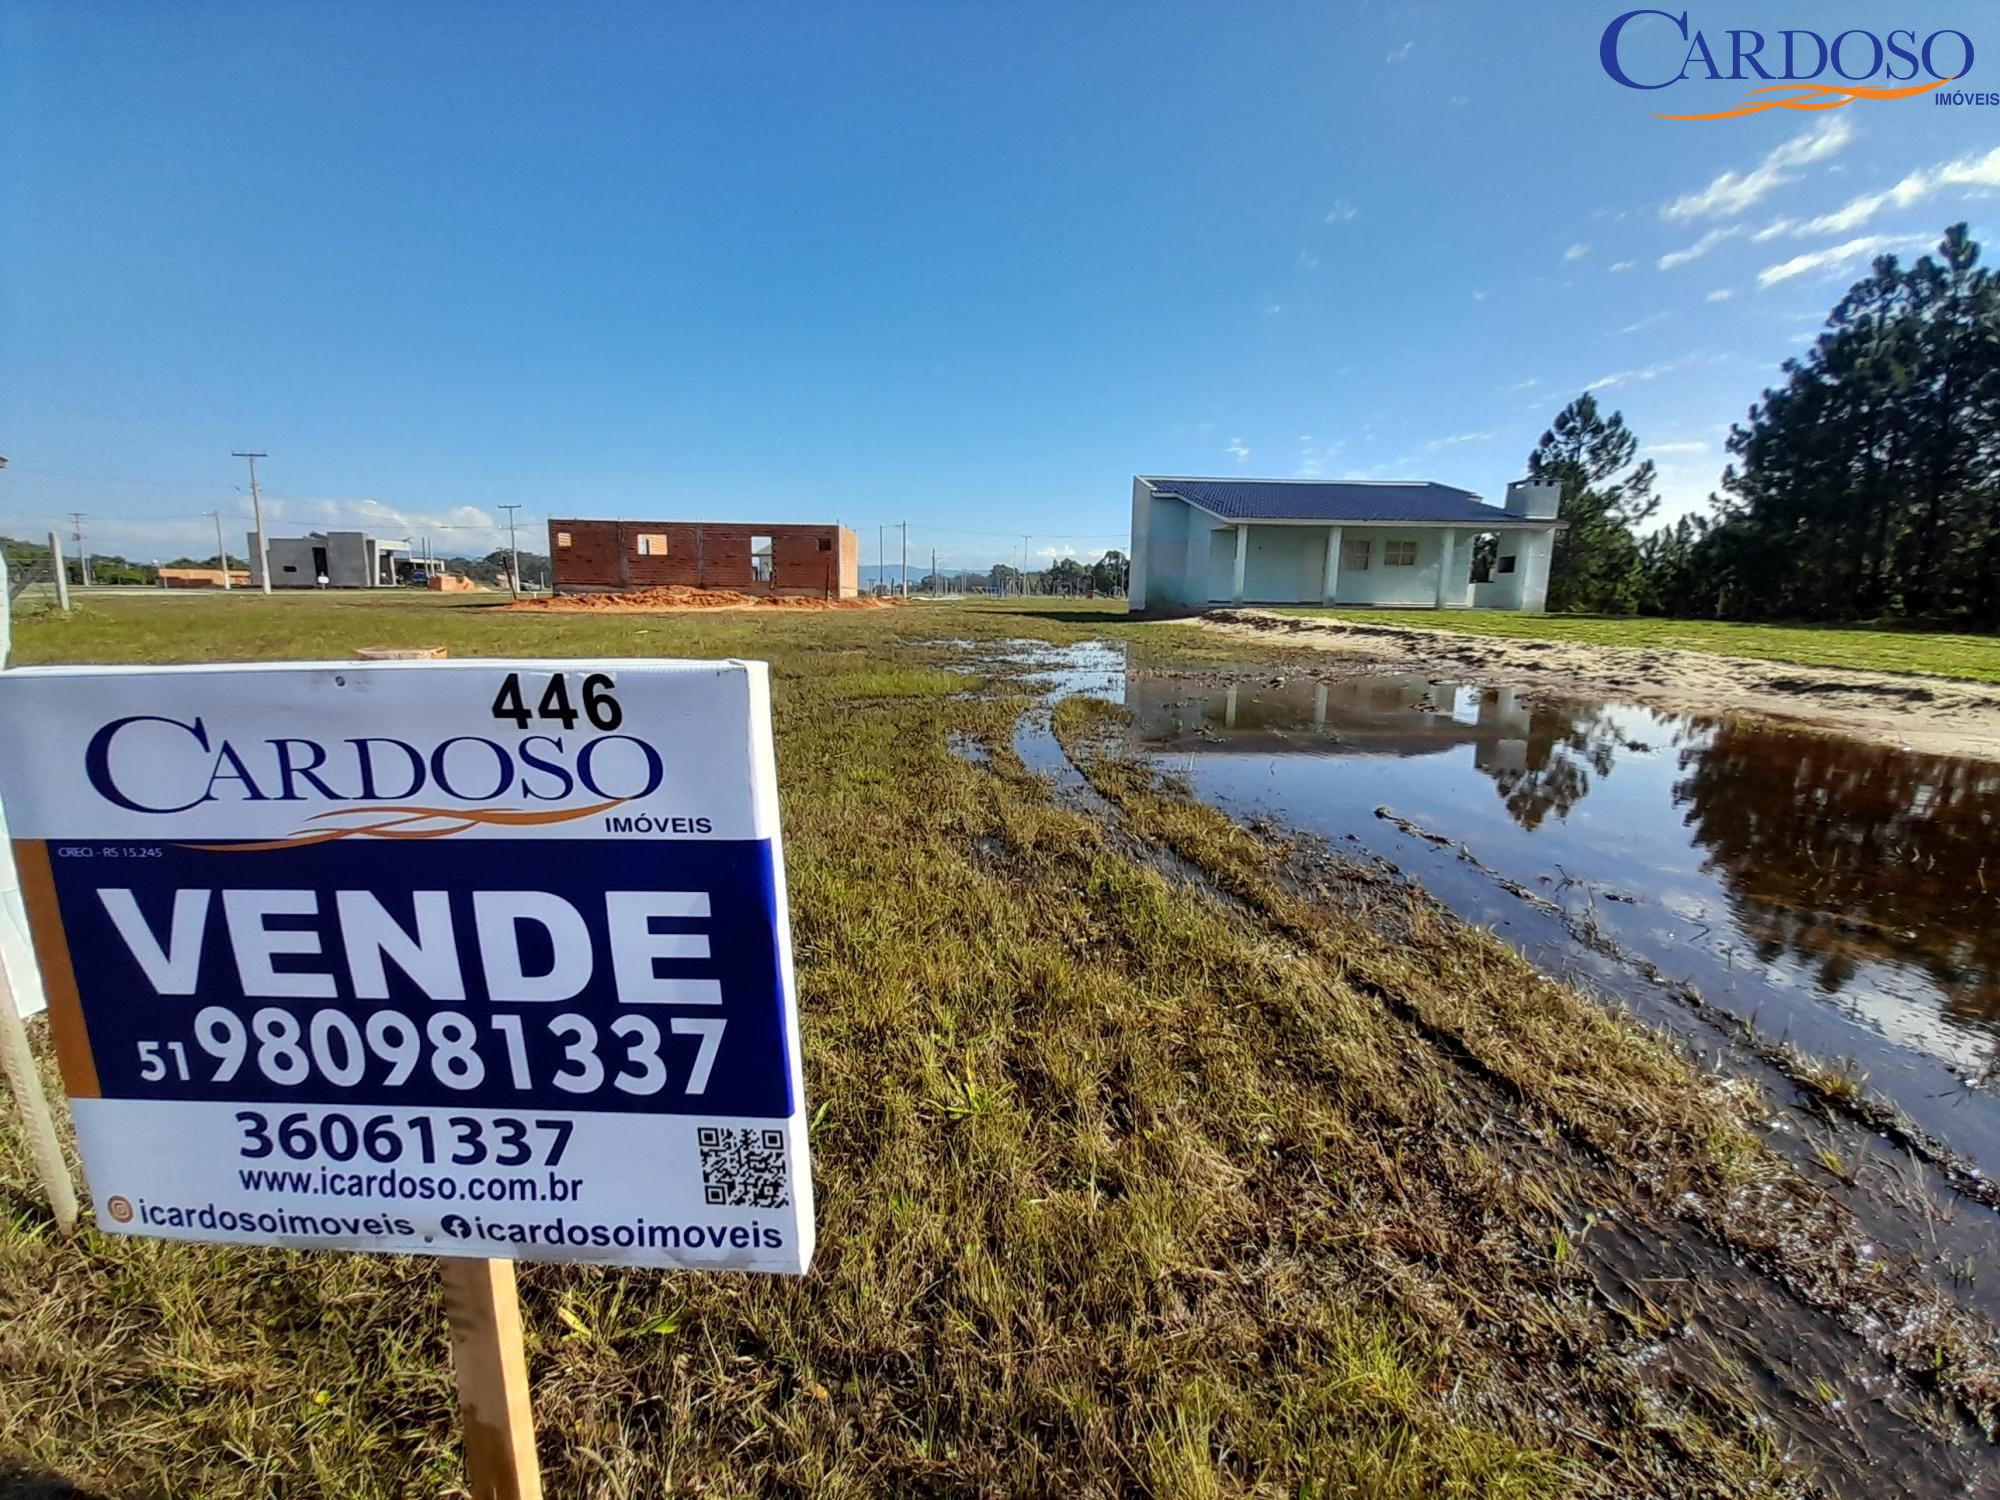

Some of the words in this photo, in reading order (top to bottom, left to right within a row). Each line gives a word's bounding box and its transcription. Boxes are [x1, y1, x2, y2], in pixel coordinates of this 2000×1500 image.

[491, 673, 623, 731] 446
[85, 716, 665, 814] CARDOSO
[605, 812, 712, 834] IMÓVEIS
[102, 847, 119, 858] RS
[122, 847, 163, 858] 15.245
[97, 888, 724, 1005] VENDE
[137, 1040, 192, 1083] 51
[194, 1006, 729, 1097] 980981337
[235, 1110, 574, 1167] 36061337
[239, 1166, 583, 1202] www.icardoso.com.br
[138, 1199, 415, 1236] icardosoimoveis
[475, 1217, 783, 1249] icardosoimoveis
